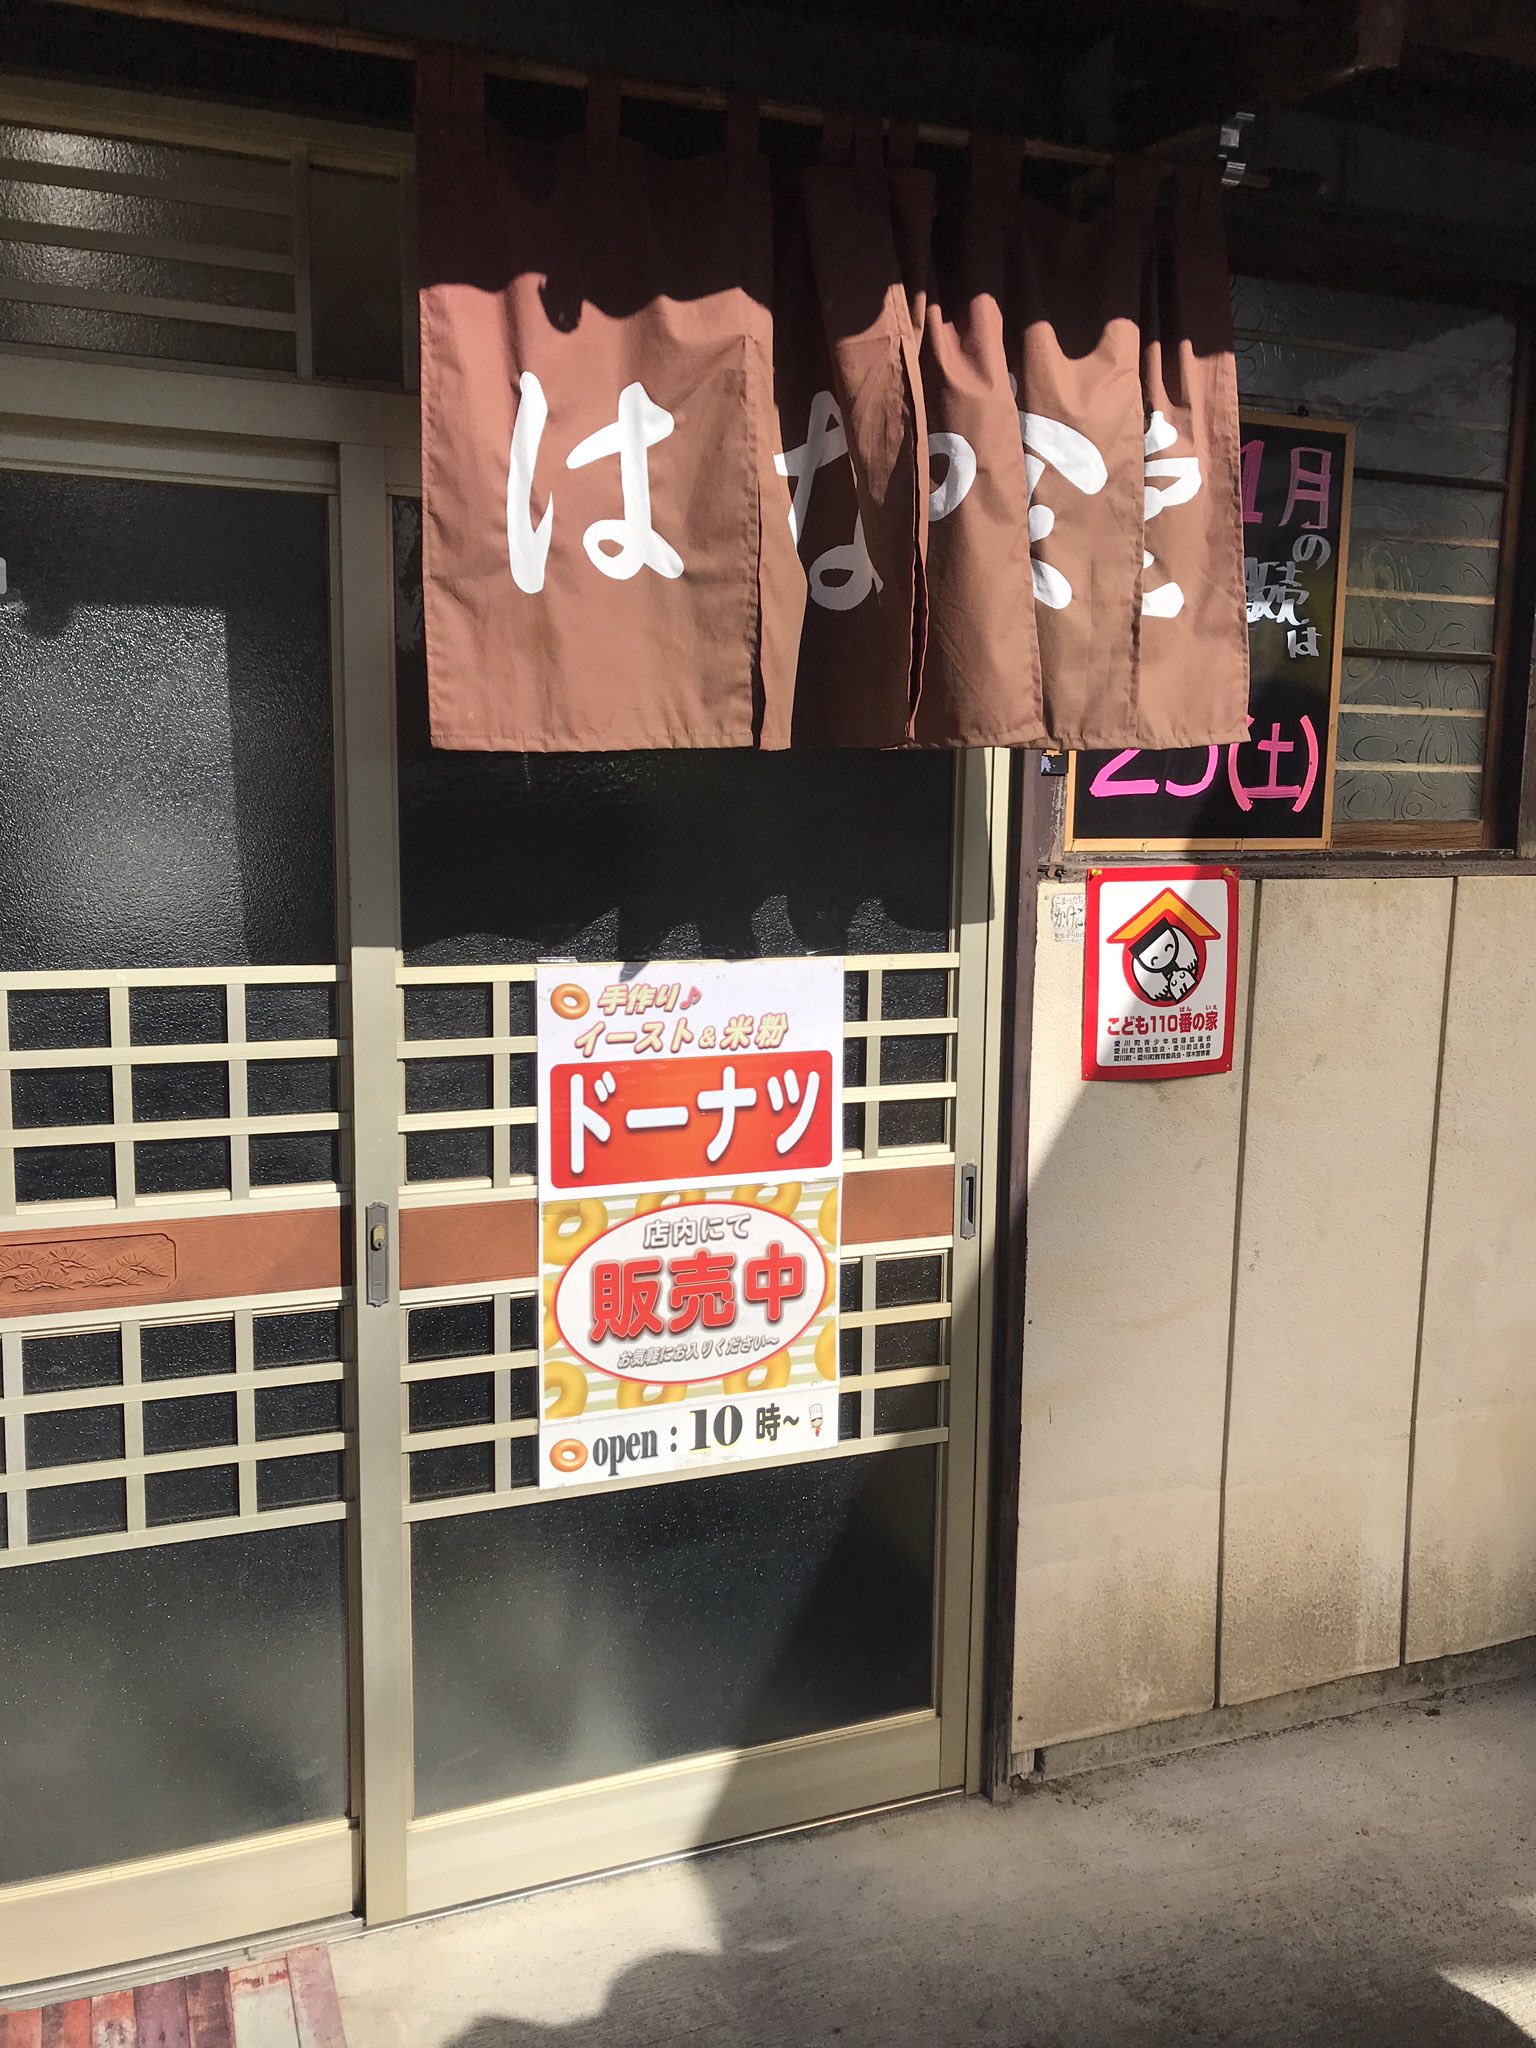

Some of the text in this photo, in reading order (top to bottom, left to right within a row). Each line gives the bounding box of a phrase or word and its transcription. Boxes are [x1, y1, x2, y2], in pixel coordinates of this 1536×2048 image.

[1107, 1011, 1219, 1036] こども110番の家
[570, 1066, 820, 1174] ドーナツ
[643, 1213, 752, 1248] 店内にて
[589, 1240, 807, 1343] 販売中
